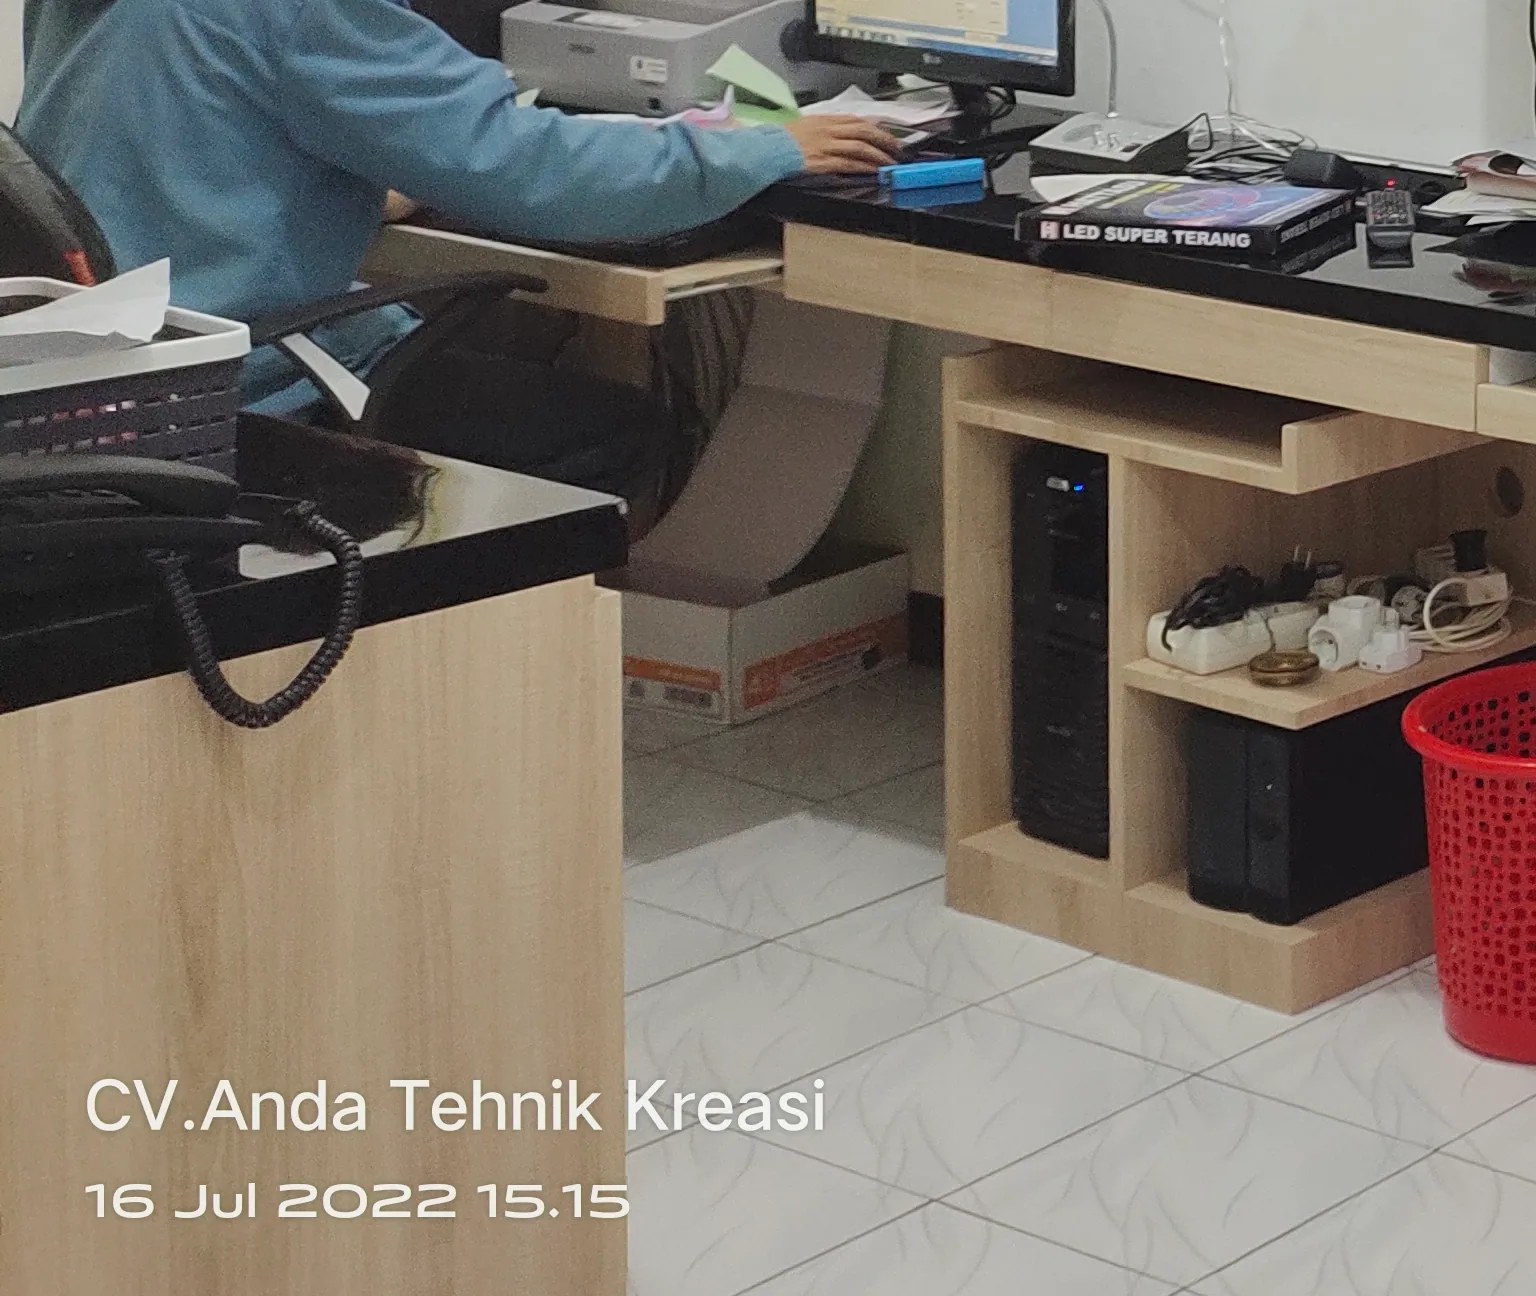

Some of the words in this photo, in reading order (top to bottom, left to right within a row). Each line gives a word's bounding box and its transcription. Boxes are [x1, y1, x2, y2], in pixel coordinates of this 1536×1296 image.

[1063, 223, 1100, 240] LED
[1104, 225, 1168, 244] SUPER
[1172, 229, 1251, 249] TERANG
